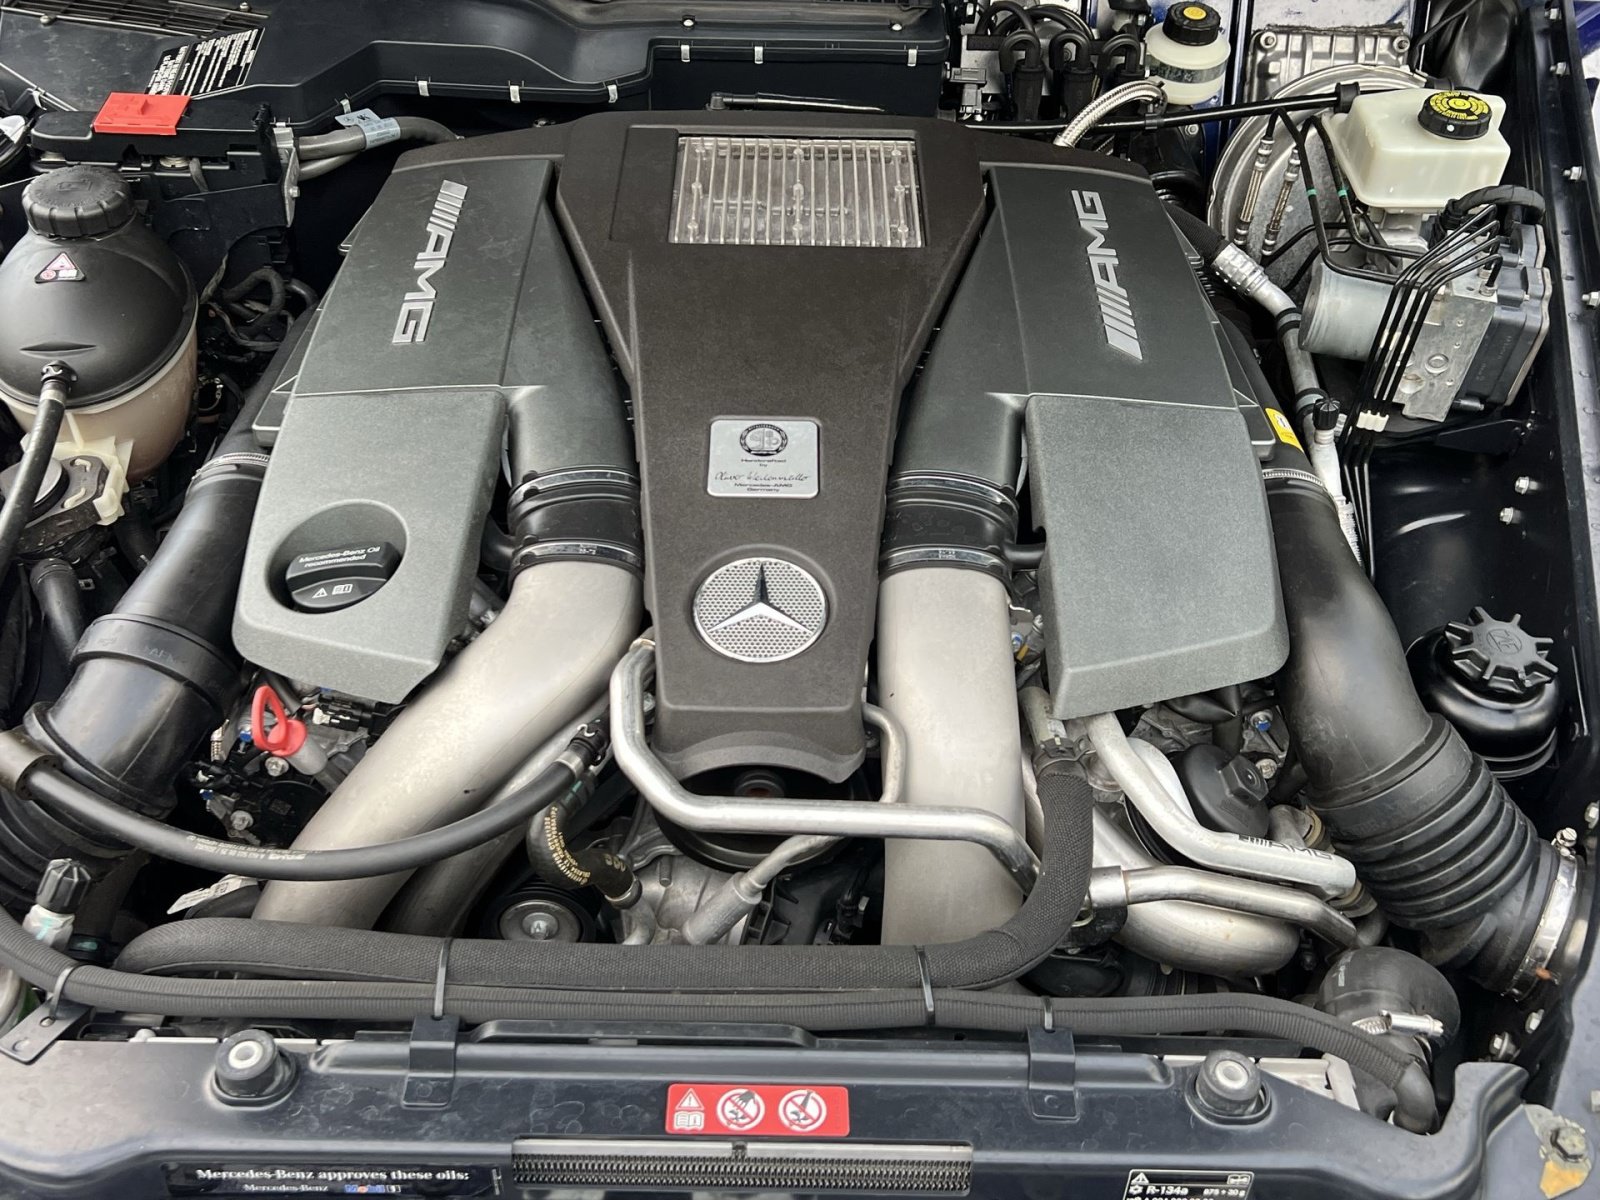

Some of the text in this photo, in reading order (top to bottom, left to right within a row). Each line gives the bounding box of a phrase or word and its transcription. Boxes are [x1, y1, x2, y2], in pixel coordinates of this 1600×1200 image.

[1071, 190, 1128, 299] AMG
[392, 223, 454, 343] AMG
[299, 549, 366, 563] Mercedes-Benz
[304, 554, 367, 568] recommended
[195, 1169, 470, 1182] Mercedes-Benz approves these oils:
[243, 1184, 328, 1192] Mercedes-Benz
[1146, 1185, 1189, 1196] R-134a
